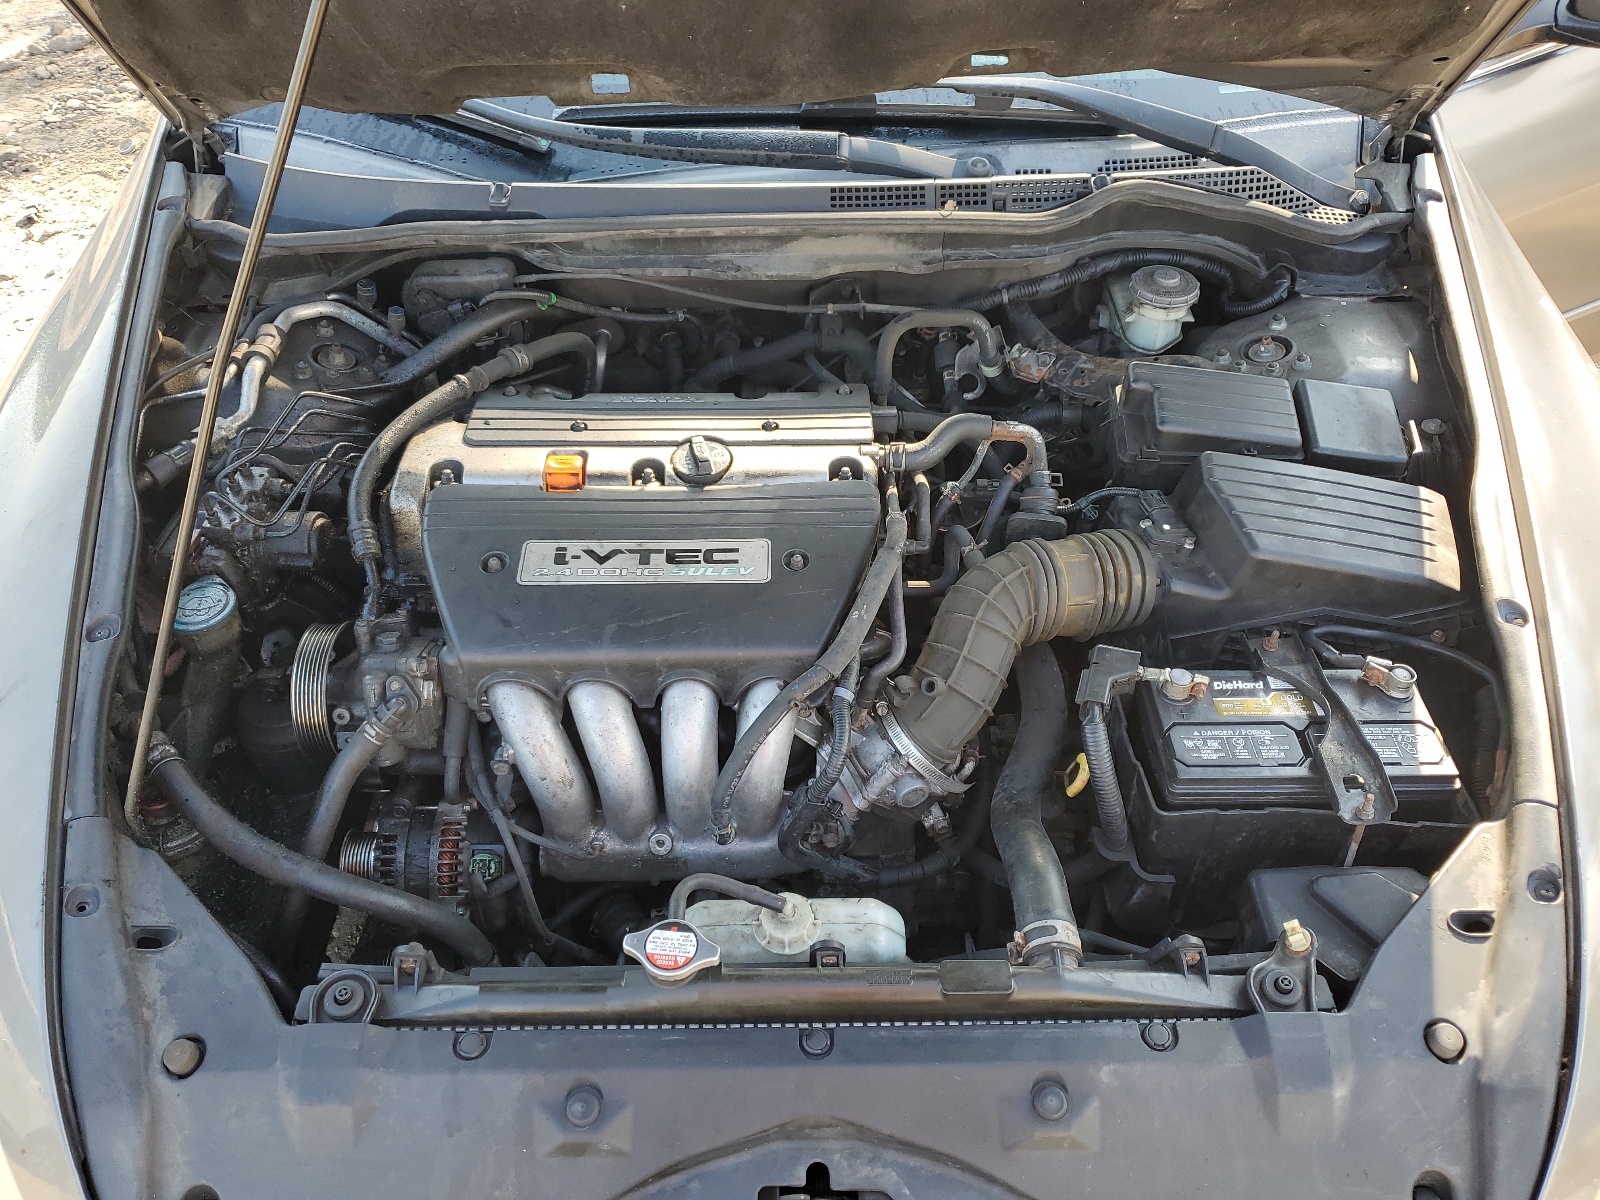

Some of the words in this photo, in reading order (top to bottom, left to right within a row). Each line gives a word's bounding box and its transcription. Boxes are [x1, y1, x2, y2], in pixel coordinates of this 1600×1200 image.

[553, 546, 740, 566] i-VTEC
[533, 567, 574, 577] 2.4
[576, 567, 665, 577] DOHC
[669, 566, 756, 576] SULEV
[1213, 680, 1264, 690] DieHard
[749, 733, 768, 755] ENGINE
